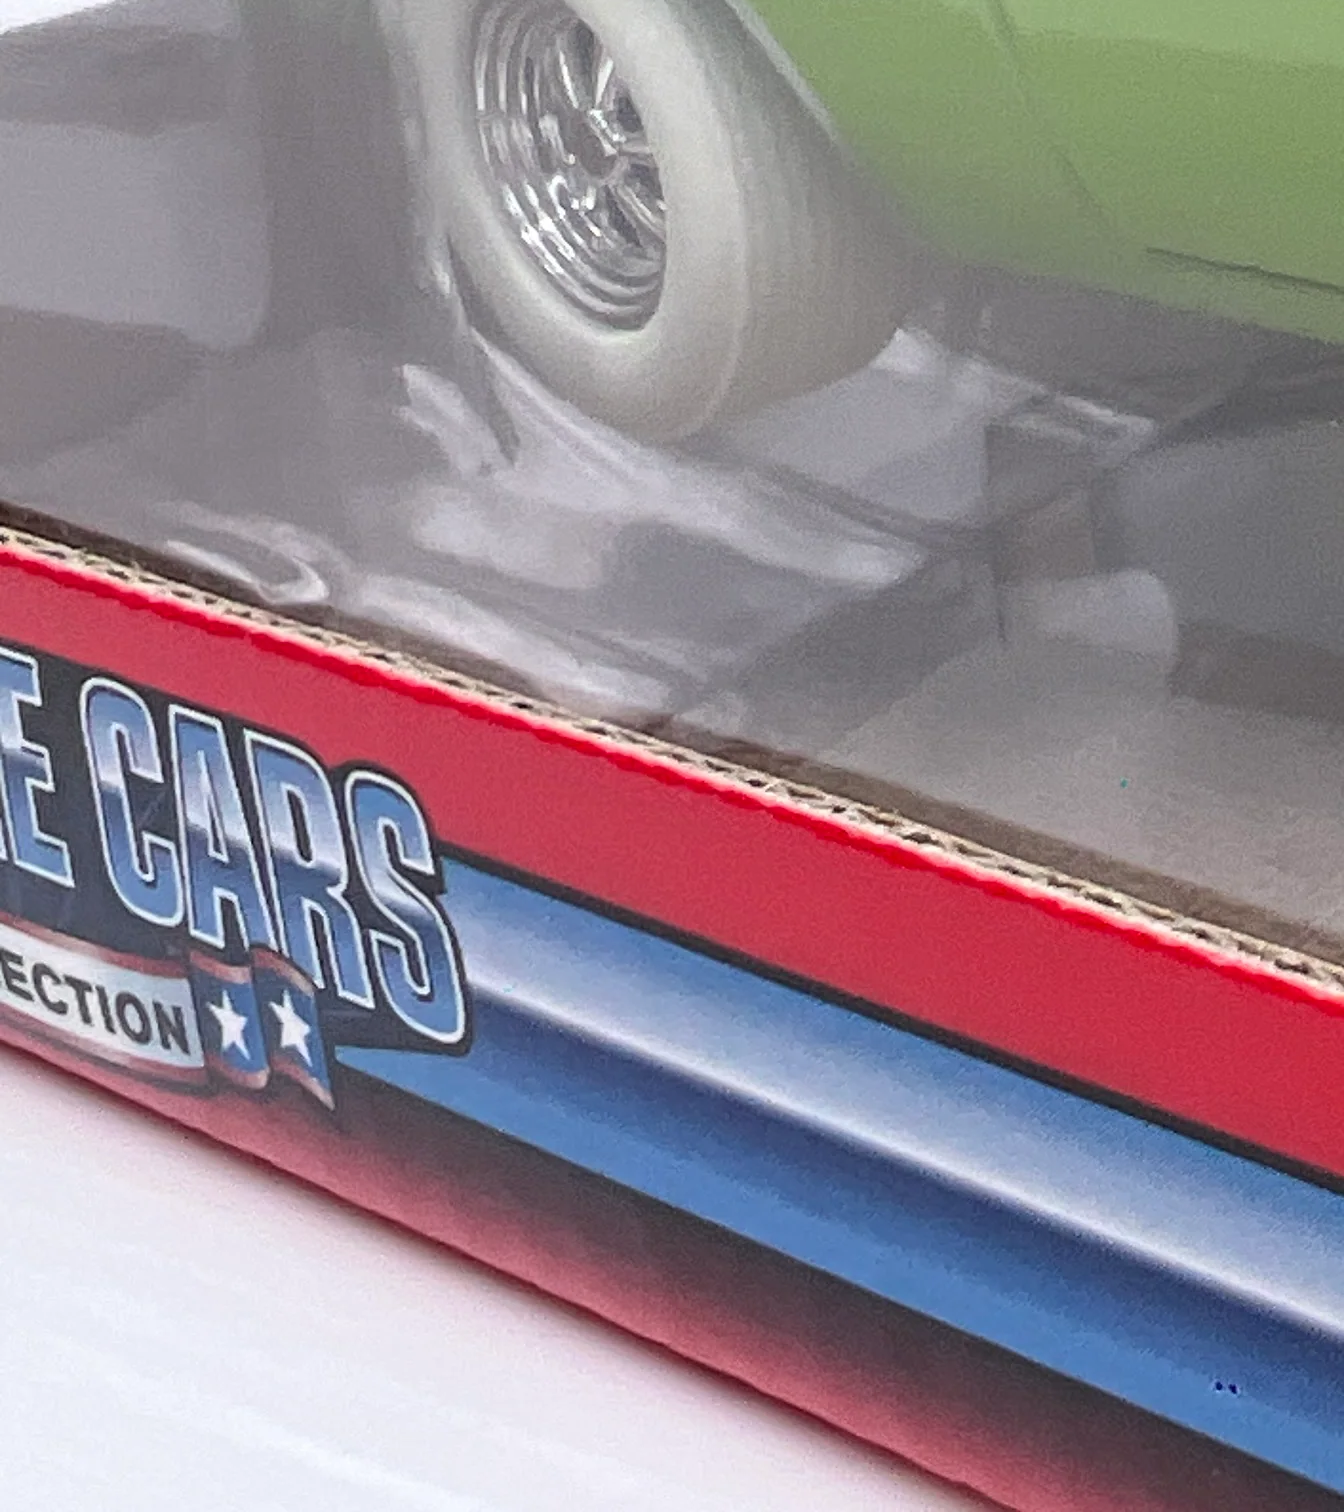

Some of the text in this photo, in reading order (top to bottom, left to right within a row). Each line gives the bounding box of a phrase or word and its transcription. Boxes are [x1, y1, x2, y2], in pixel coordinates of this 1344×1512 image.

[0, 645, 468, 1045] E CARS
[0, 947, 192, 1056] ECTION
